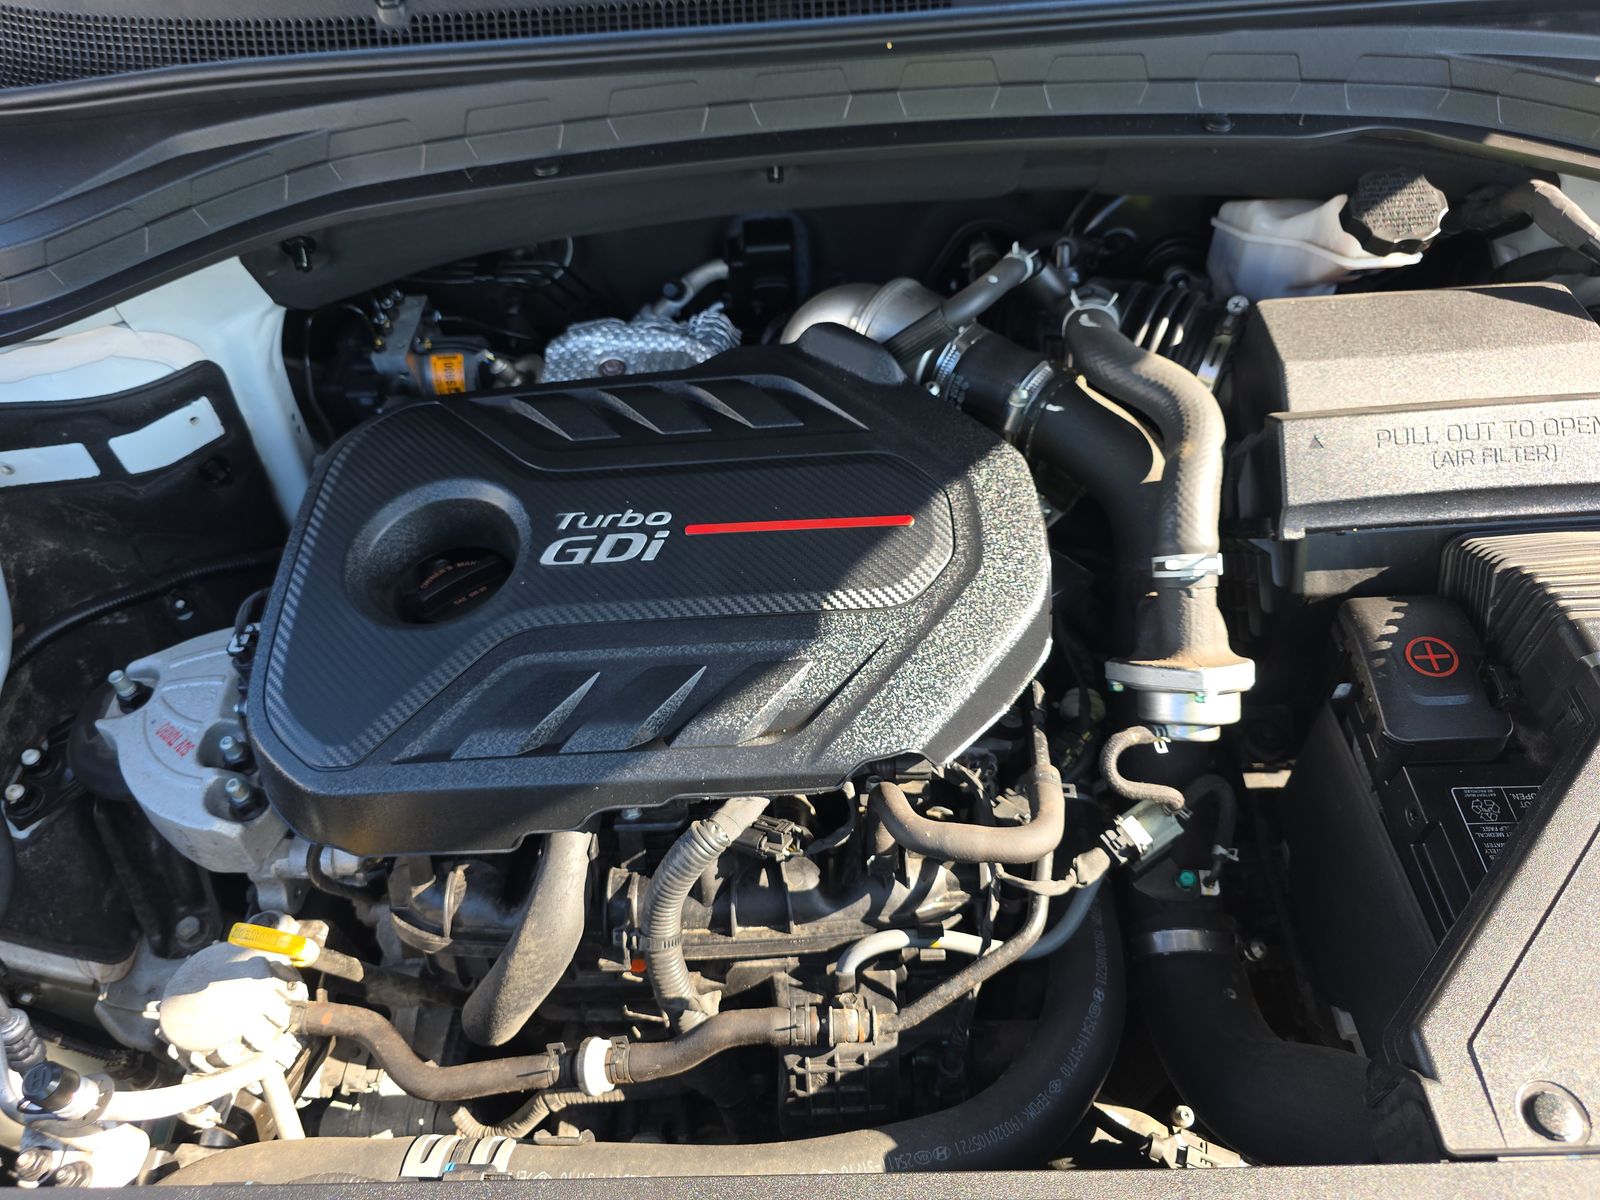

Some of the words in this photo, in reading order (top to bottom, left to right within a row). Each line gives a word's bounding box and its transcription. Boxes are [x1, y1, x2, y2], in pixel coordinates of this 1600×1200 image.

[1376, 426, 1439, 448] PULL
[1446, 421, 1496, 442] OUT
[1503, 419, 1535, 440] TO
[555, 508, 672, 531] Turbo
[539, 530, 670, 566] GDi
